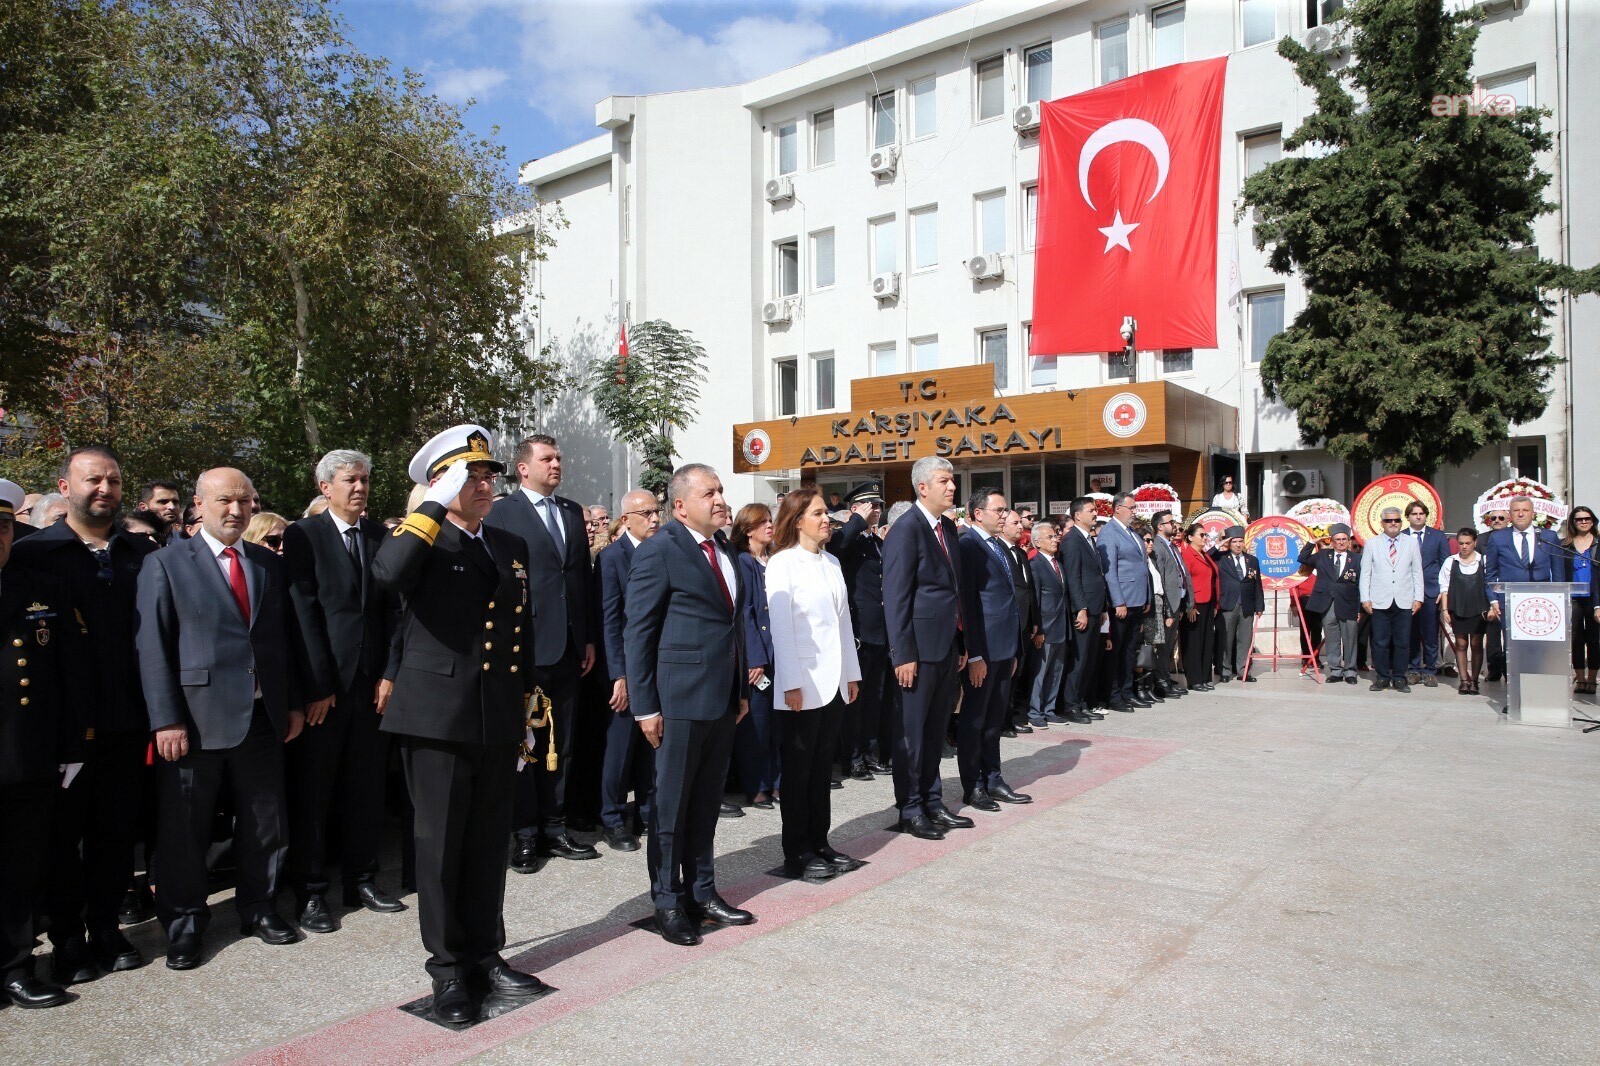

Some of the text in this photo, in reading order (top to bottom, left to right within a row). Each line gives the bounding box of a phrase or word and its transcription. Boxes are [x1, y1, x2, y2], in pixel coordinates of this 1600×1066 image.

[898, 378, 947, 403] T.C.
[831, 402, 1017, 439] KARŞIYAKA
[800, 438, 915, 466] ADALET
[935, 426, 1062, 457] SARAYI
[1261, 558, 1294, 567] KARŞIYAKA
